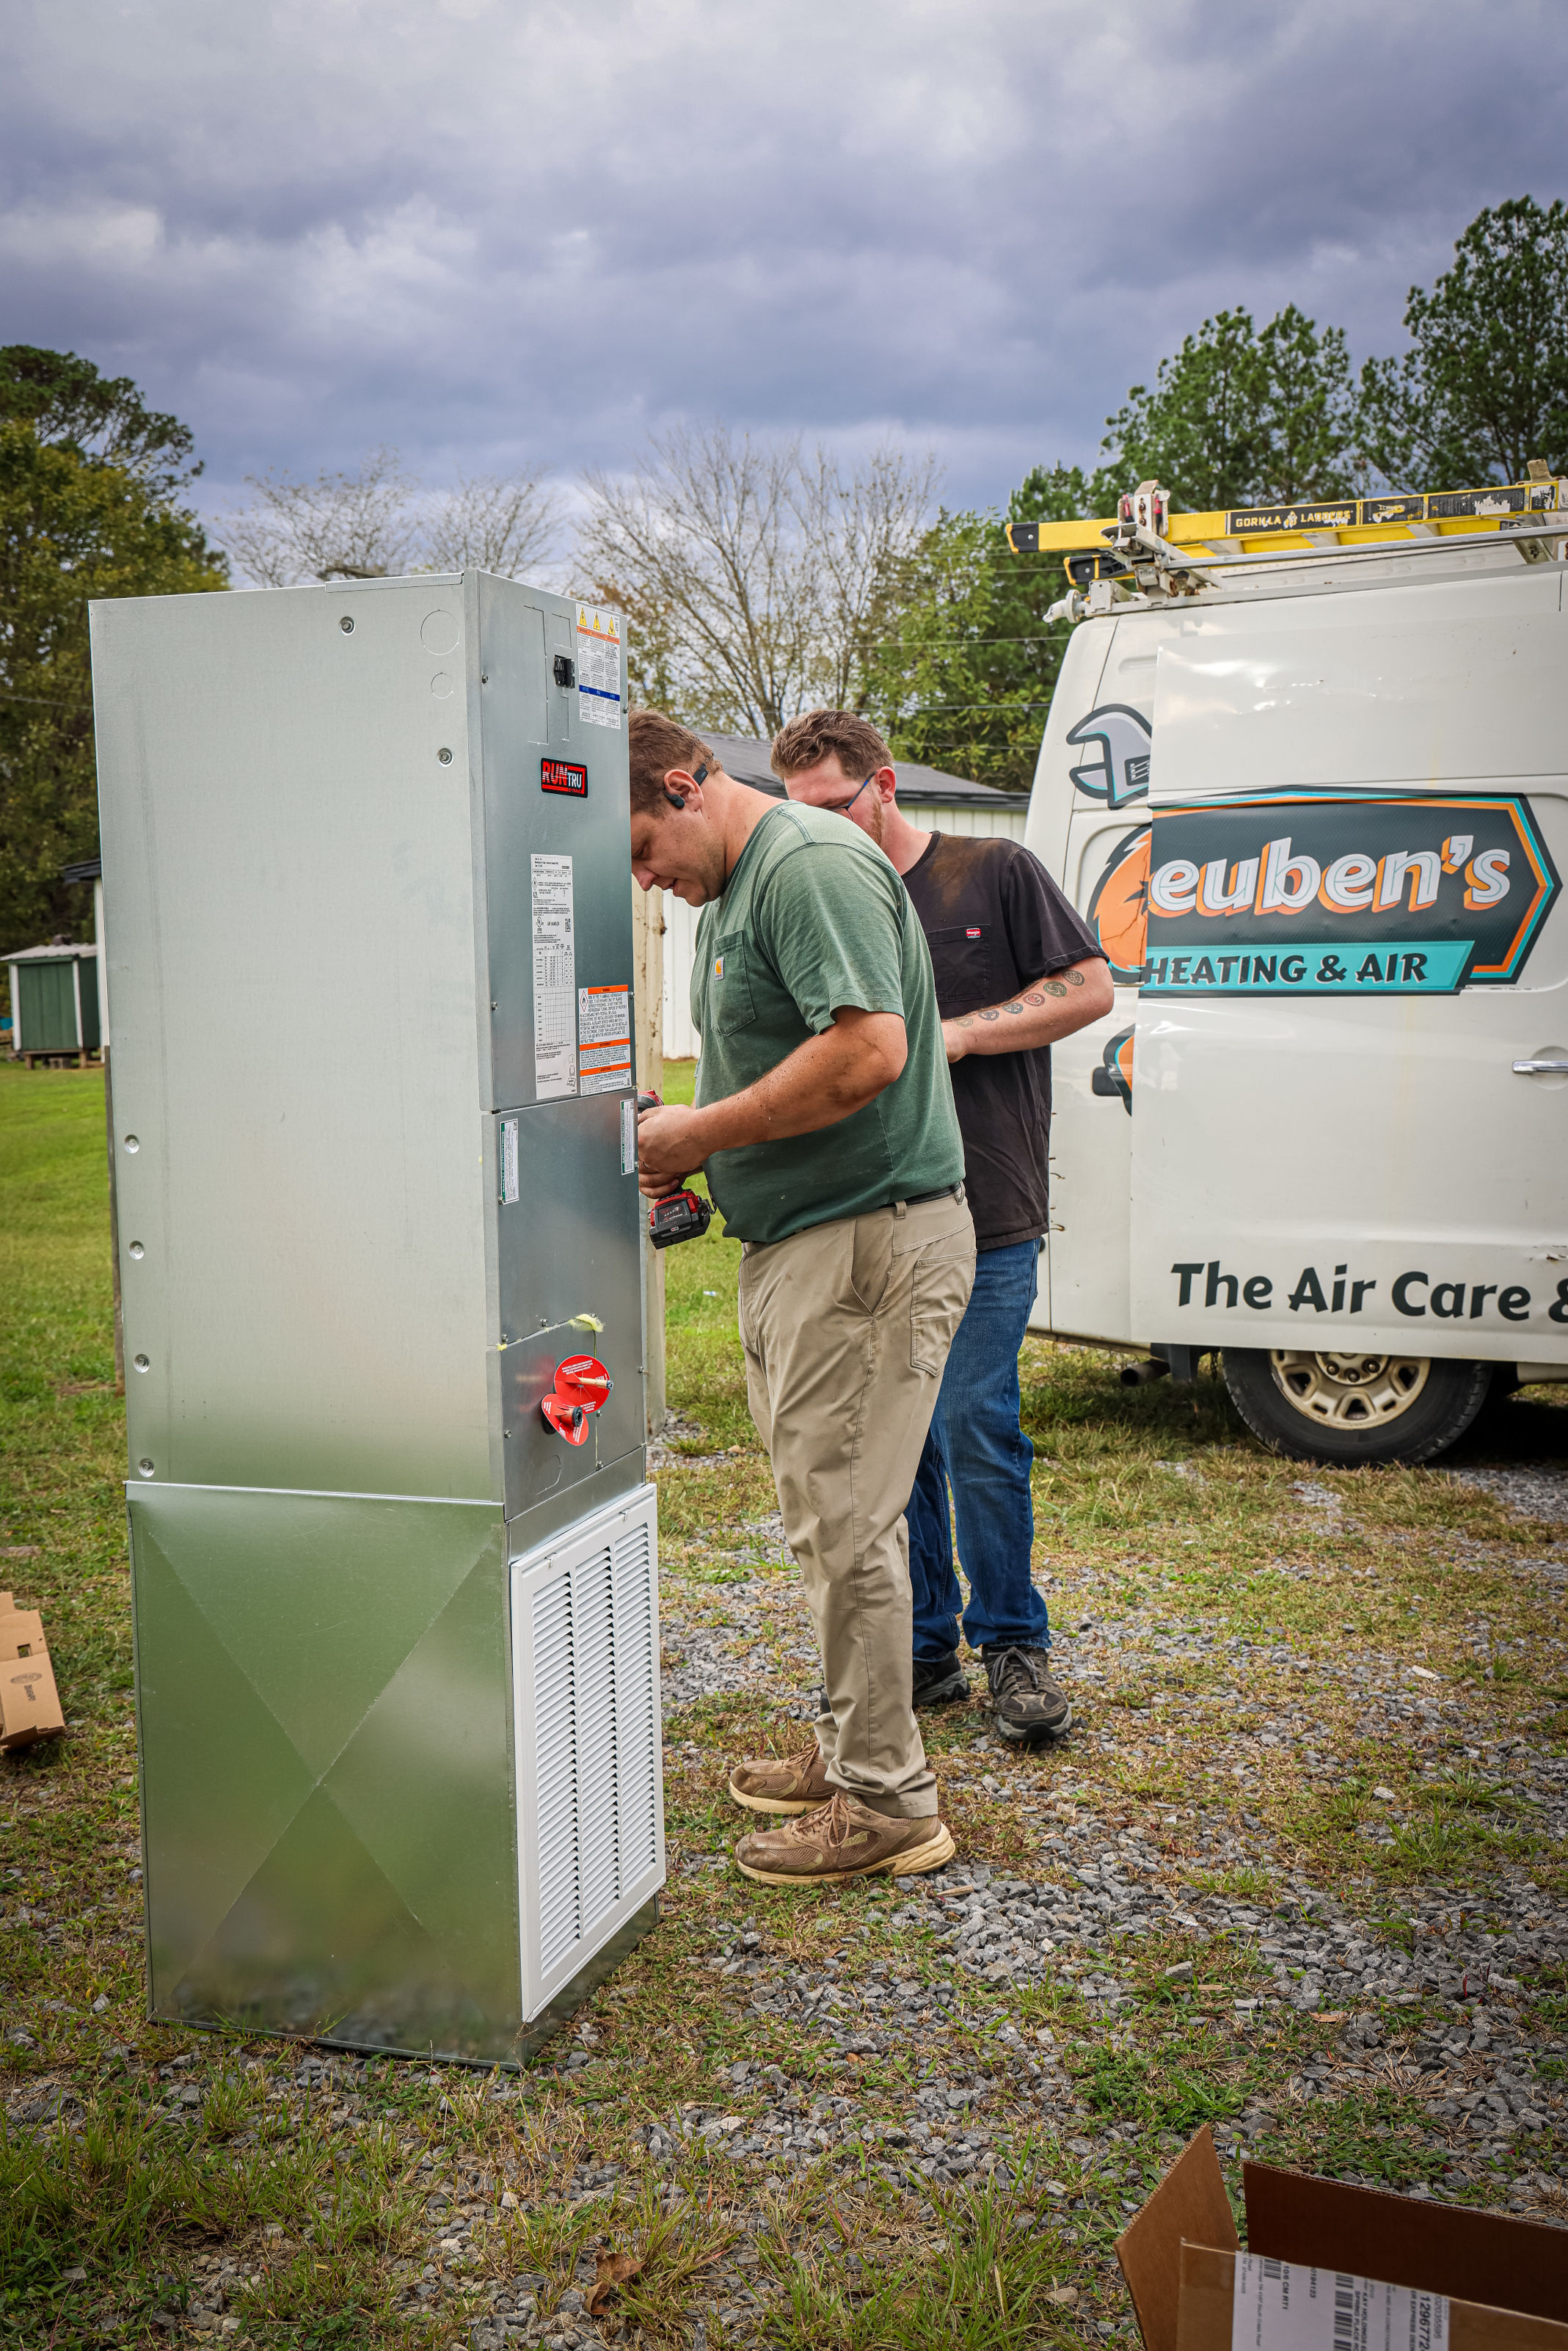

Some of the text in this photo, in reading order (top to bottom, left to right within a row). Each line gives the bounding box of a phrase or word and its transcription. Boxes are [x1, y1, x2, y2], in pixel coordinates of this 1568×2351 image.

[1236, 515, 1282, 528] GORILLA
[1142, 953, 1428, 985] HEATING & AIR
[1170, 1260, 1568, 1323] The Air Care &
[1283, 2281, 1289, 2294] CM
[1419, 2296, 1431, 2351] 1296772
